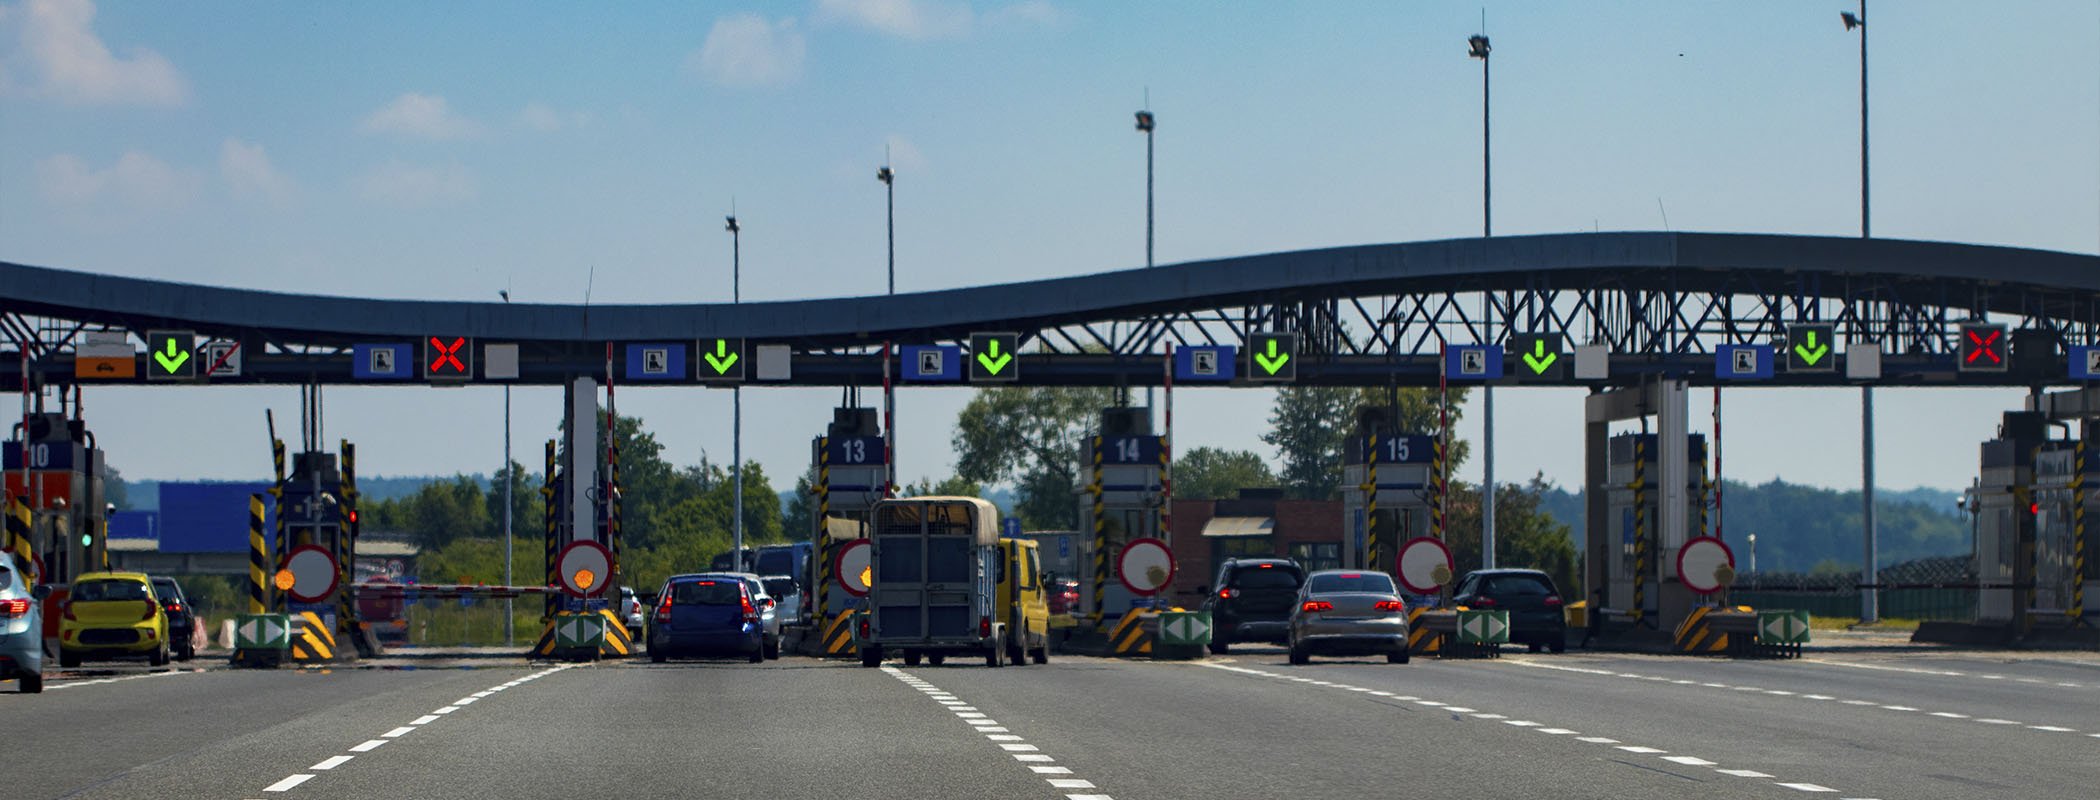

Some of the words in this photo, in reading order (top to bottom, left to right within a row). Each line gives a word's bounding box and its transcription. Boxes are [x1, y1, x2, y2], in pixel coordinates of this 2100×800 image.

[842, 439, 866, 463] 13
[1115, 438, 1141, 462] 14
[1387, 437, 1410, 461] 15
